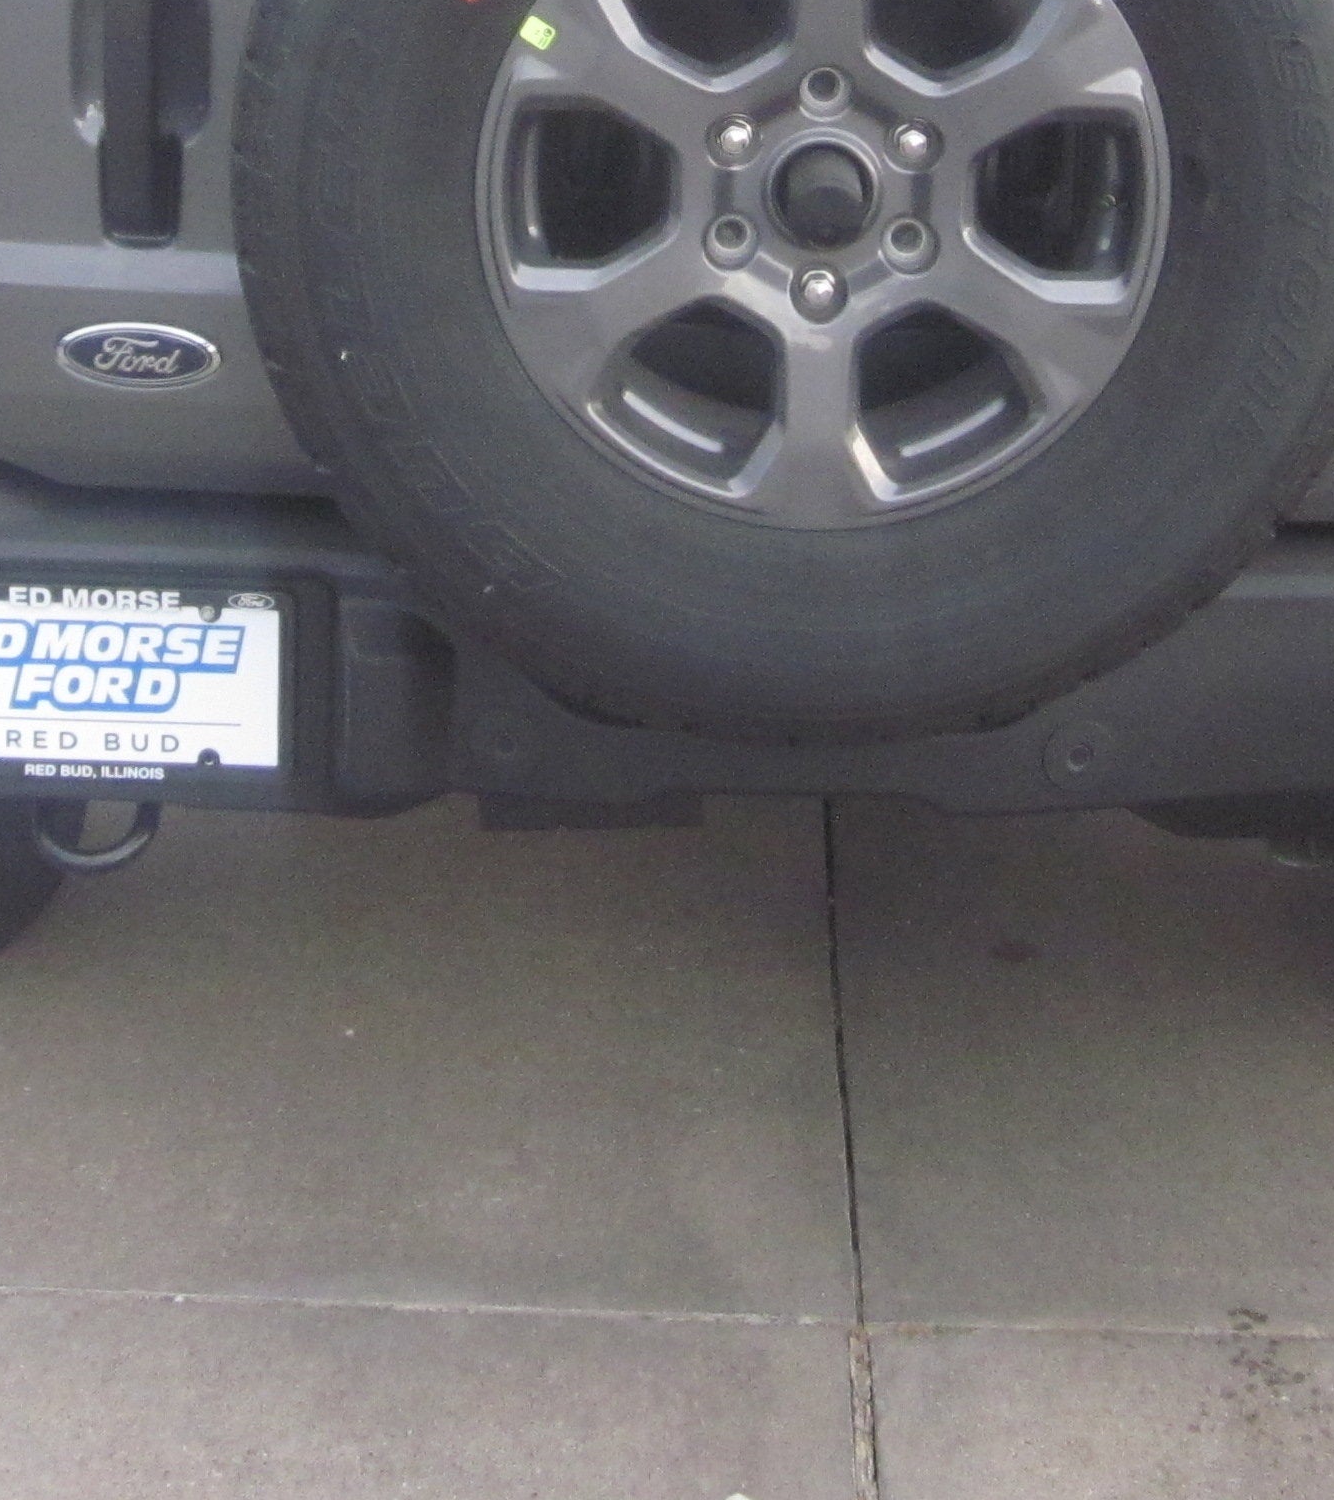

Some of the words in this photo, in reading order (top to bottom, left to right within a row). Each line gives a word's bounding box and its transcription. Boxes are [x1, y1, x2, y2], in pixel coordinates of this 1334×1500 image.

[93, 336, 181, 374] Ford
[8, 586, 52, 607] ED
[62, 588, 180, 612] MORSE
[30, 621, 245, 673] MORSE
[10, 664, 180, 712] FORD
[5, 729, 78, 750] RED
[104, 732, 180, 753] BUD
[24, 763, 56, 777] RED
[59, 764, 97, 779] BUD,
[101, 766, 165, 780] ILLINOIS
